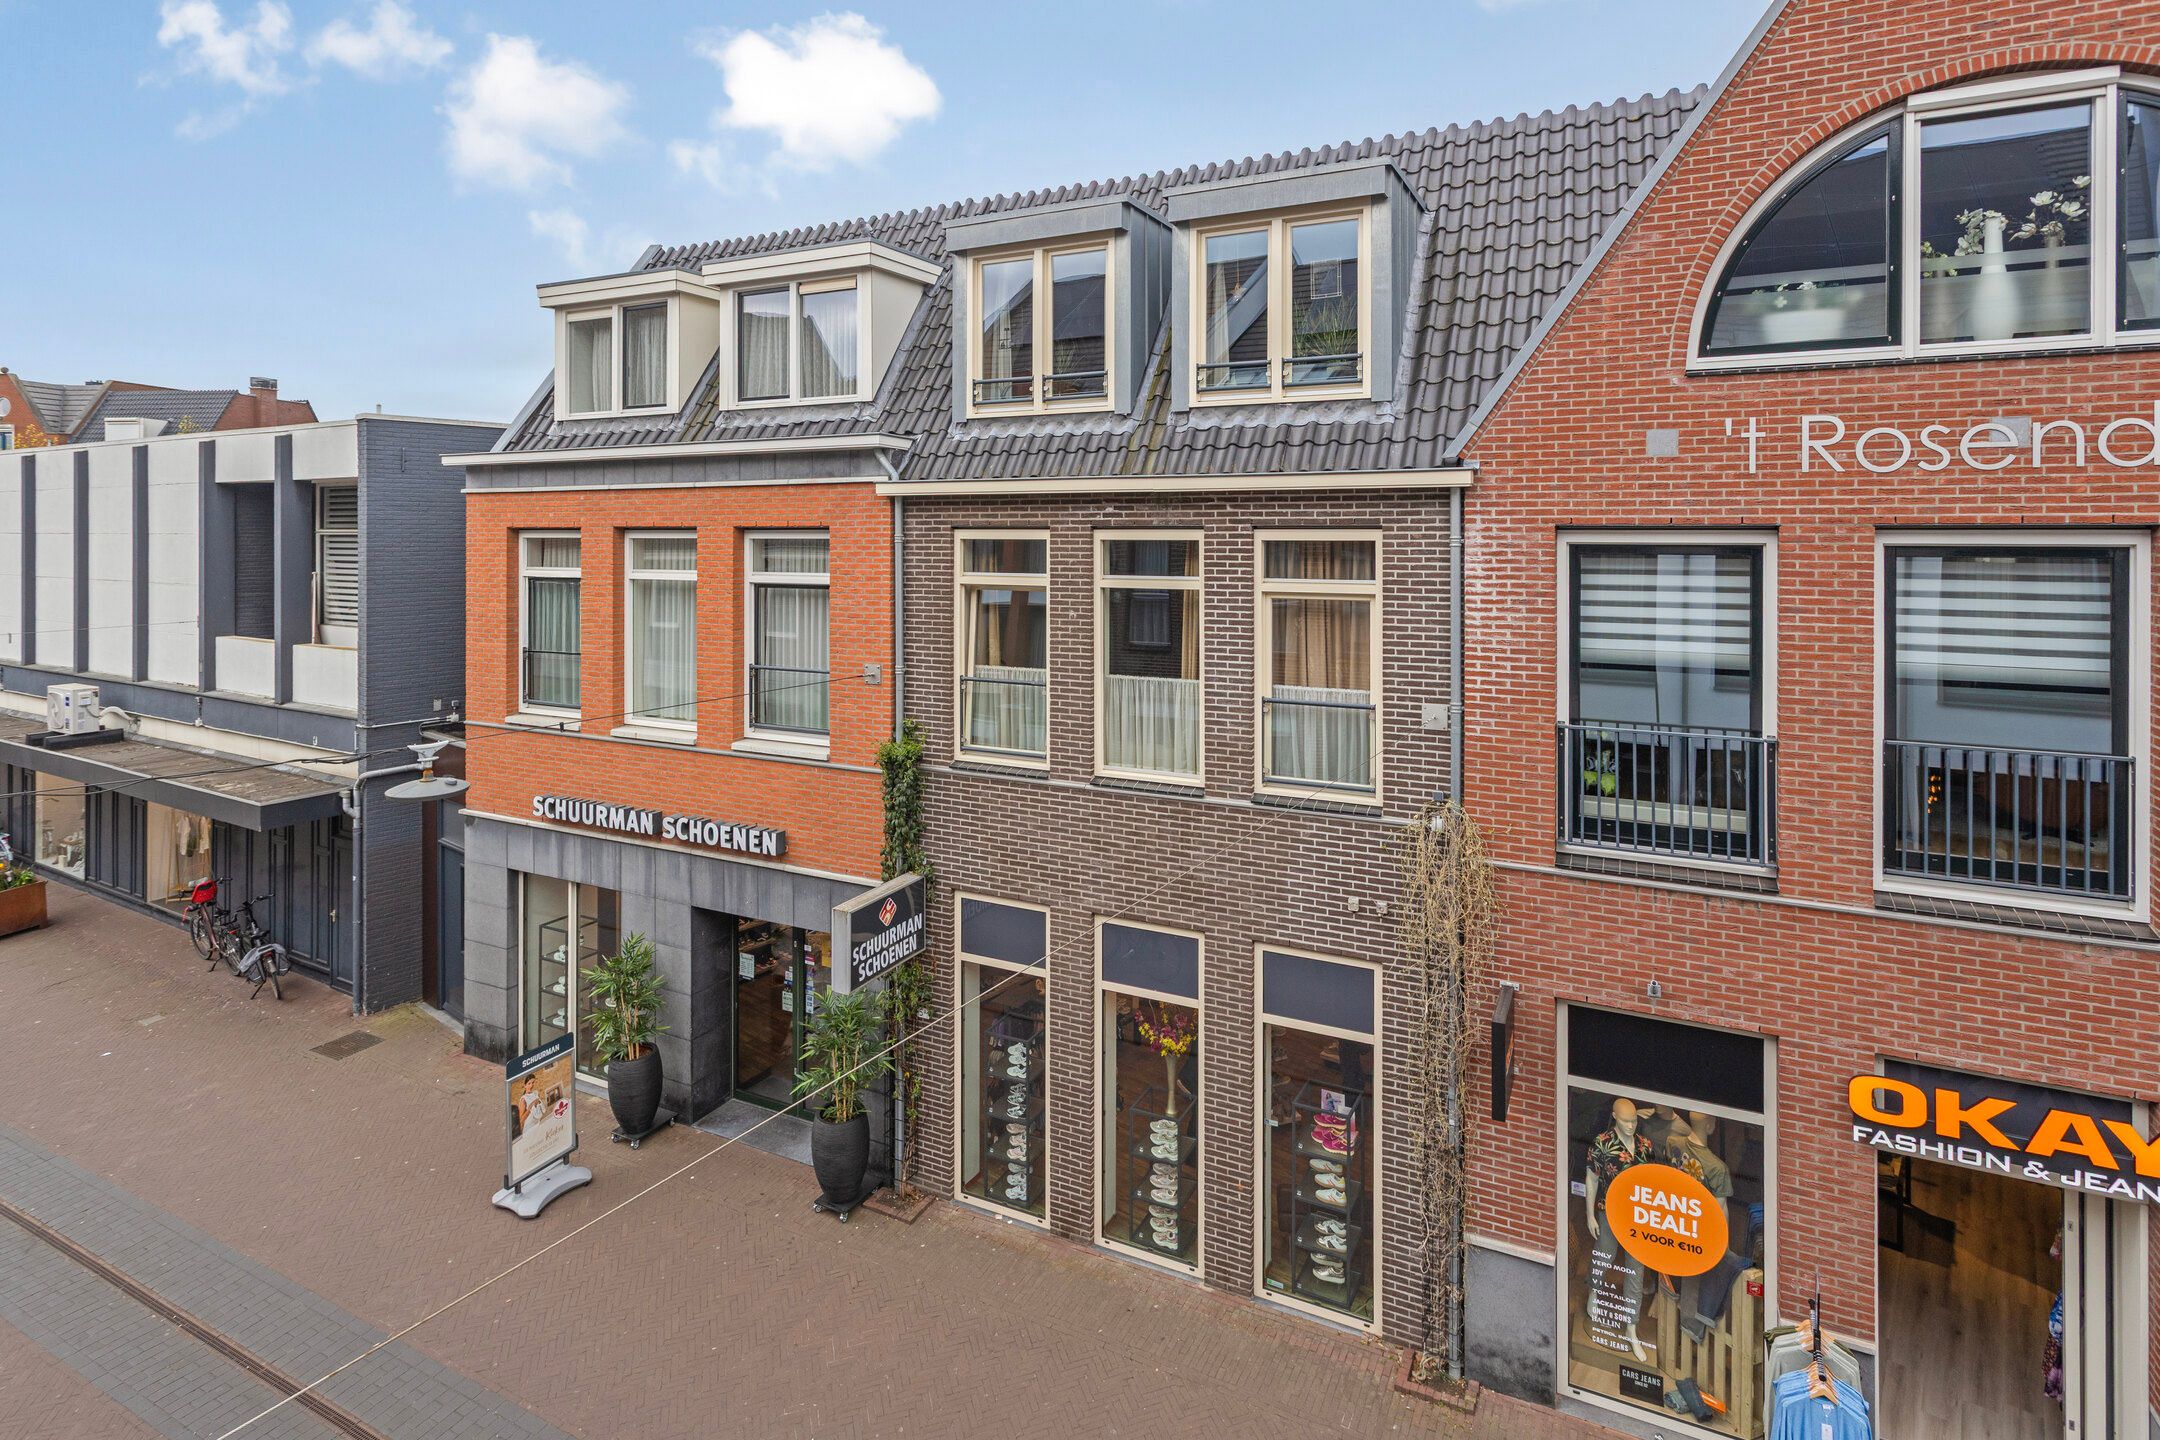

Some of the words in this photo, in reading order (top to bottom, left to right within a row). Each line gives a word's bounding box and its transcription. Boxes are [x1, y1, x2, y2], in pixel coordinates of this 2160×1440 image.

[1724, 416, 1766, 474] 't
[1801, 400, 2160, 473] Rosend
[532, 795, 655, 835] SCHUURMAN
[662, 816, 778, 856] SCHOENEN
[852, 913, 923, 966] SCHUURMAN
[858, 934, 918, 982] SCHOENEN
[522, 1043, 560, 1068] SCHUURMAN
[1848, 1075, 2160, 1178] OKAY
[1852, 1125, 2011, 1172] FASHION
[2022, 1160, 2050, 1182] &
[2060, 1169, 2160, 1207] JEAN
[1629, 1185, 1702, 1217] JEANS
[1633, 1206, 1698, 1238] DEAL!
[1591, 1249, 1612, 1259] ONLY
[1629, 1228, 1637, 1238] 2
[1641, 1231, 1675, 1248] VOOR
[1678, 1241, 1703, 1255] €110
[1591, 1259, 1612, 1269] VERO
[1613, 1264, 1637, 1275] MODA
[1592, 1306, 1610, 1317] ONLY
[1614, 1313, 1632, 1324] SONS
[1592, 1335, 1609, 1346] CARS
[1609, 1341, 1629, 1353] JEANS
[1622, 1369, 1640, 1380] CARS
[1640, 1374, 1661, 1387] JEANS
